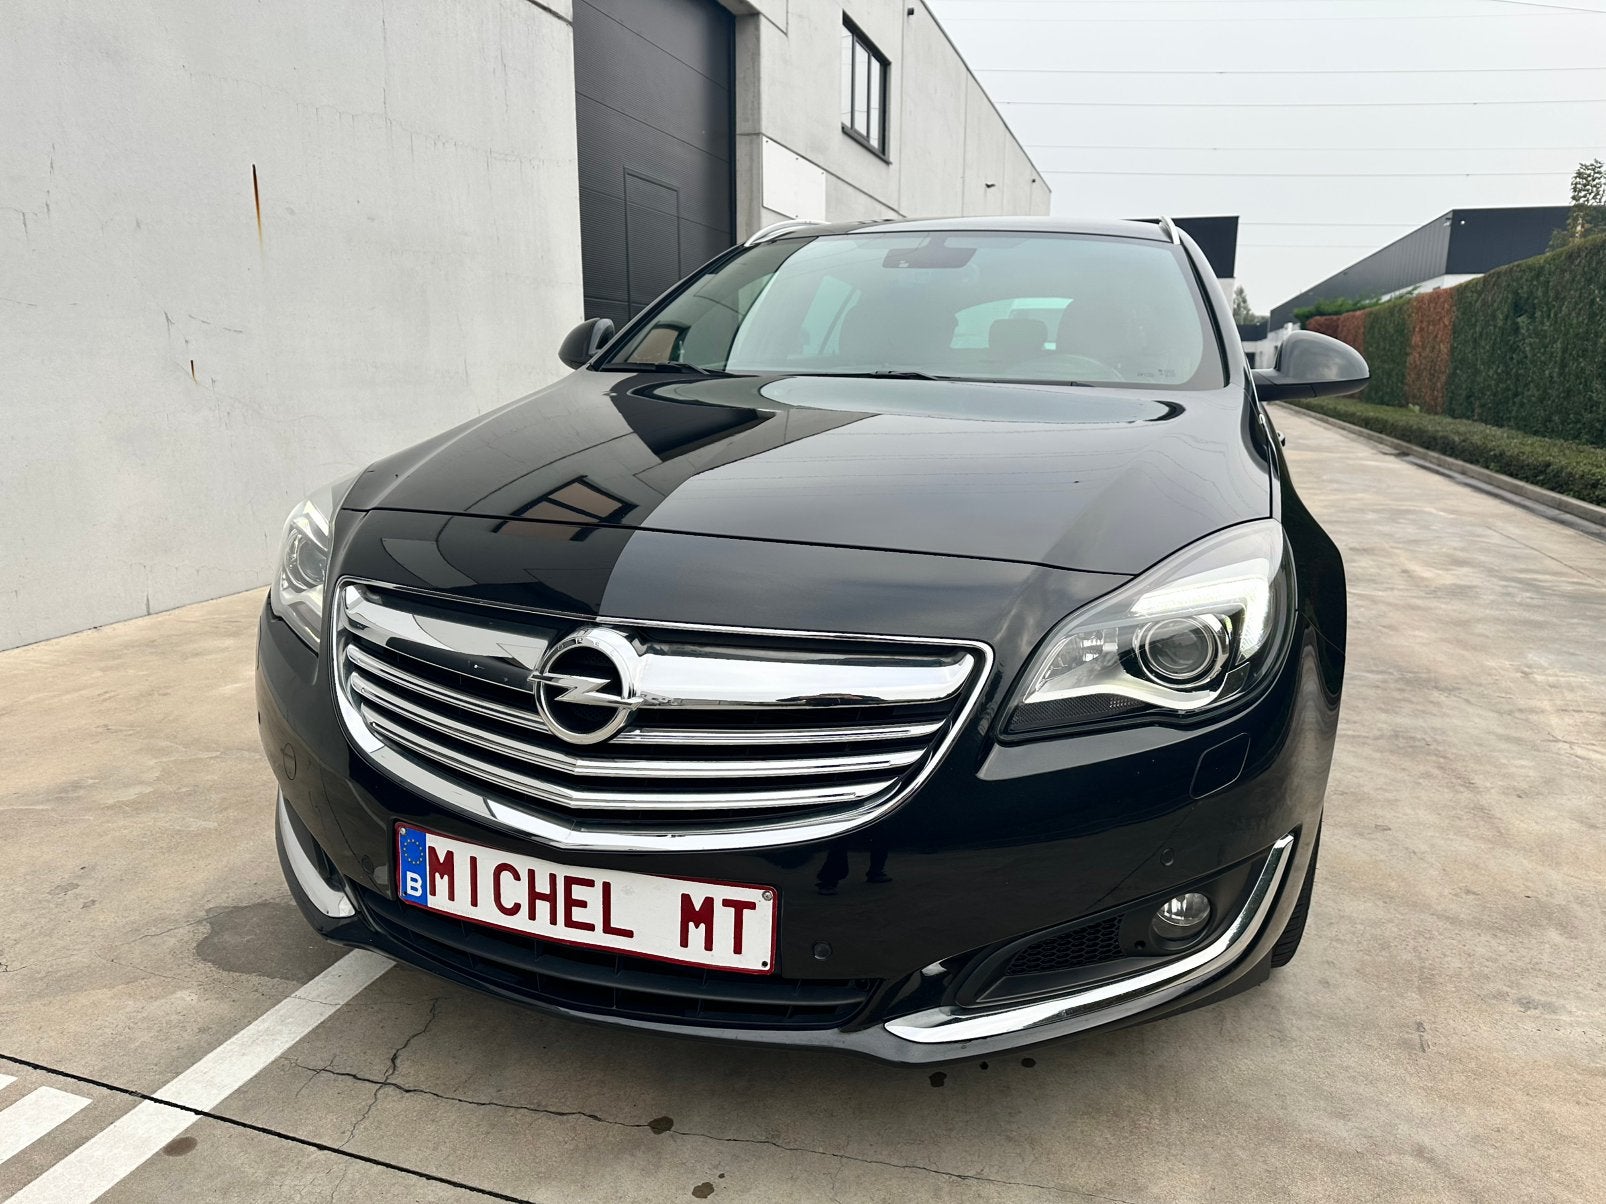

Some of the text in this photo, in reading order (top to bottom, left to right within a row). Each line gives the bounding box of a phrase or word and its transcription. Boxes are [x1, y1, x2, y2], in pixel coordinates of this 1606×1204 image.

[406, 871, 422, 897] B
[428, 846, 756, 954] MICHEL MT
